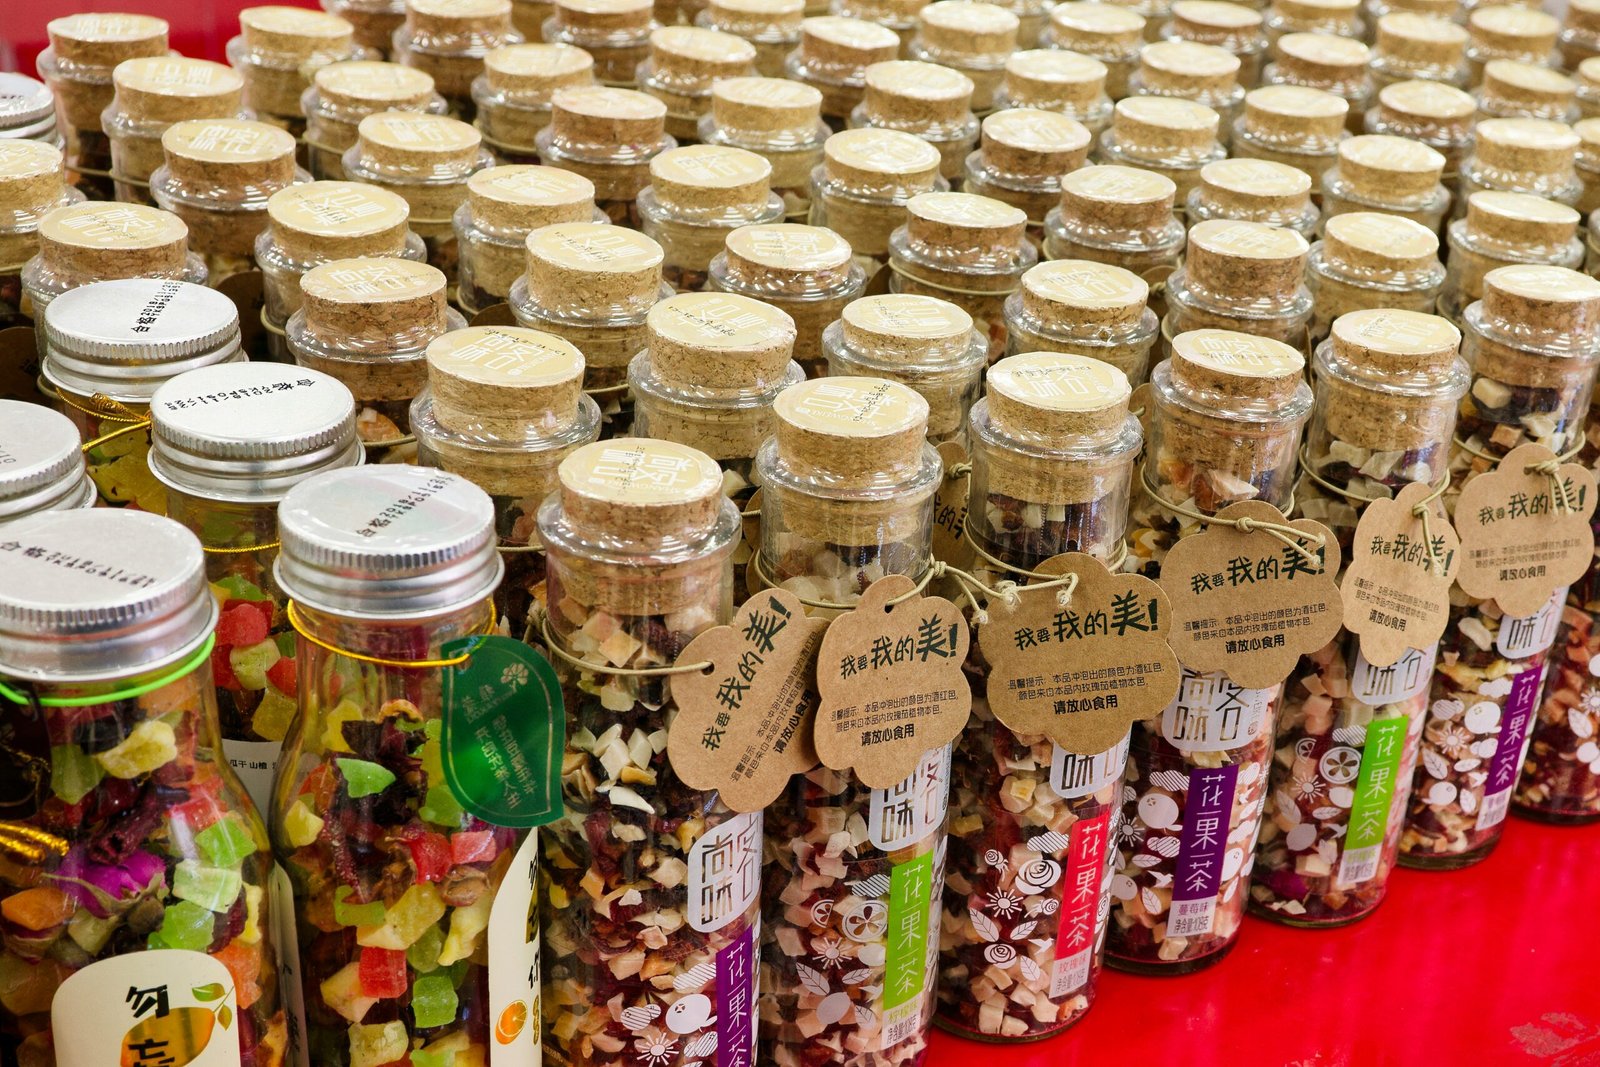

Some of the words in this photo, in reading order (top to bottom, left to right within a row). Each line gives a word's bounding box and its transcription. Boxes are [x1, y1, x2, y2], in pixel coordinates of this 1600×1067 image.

[1191, 538, 1326, 594] 我要我的美!
[840, 613, 958, 680] 我要我的美!
[1014, 590, 1158, 651] 我要我的美!
[1225, 634, 1285, 654] 请放心食用
[1369, 608, 1407, 632] 请放心食用
[702, 595, 792, 752] 我要我的美!
[1053, 694, 1118, 715] 请放心食用
[773, 688, 814, 755] 请放心食用
[861, 723, 915, 746] 请放心食用
[1495, 675, 1536, 787] 花果茶
[1357, 725, 1399, 841] 花果茶
[1185, 774, 1226, 892] 花果茶
[1066, 822, 1103, 950] 花果茶
[896, 863, 925, 997] 花果茶
